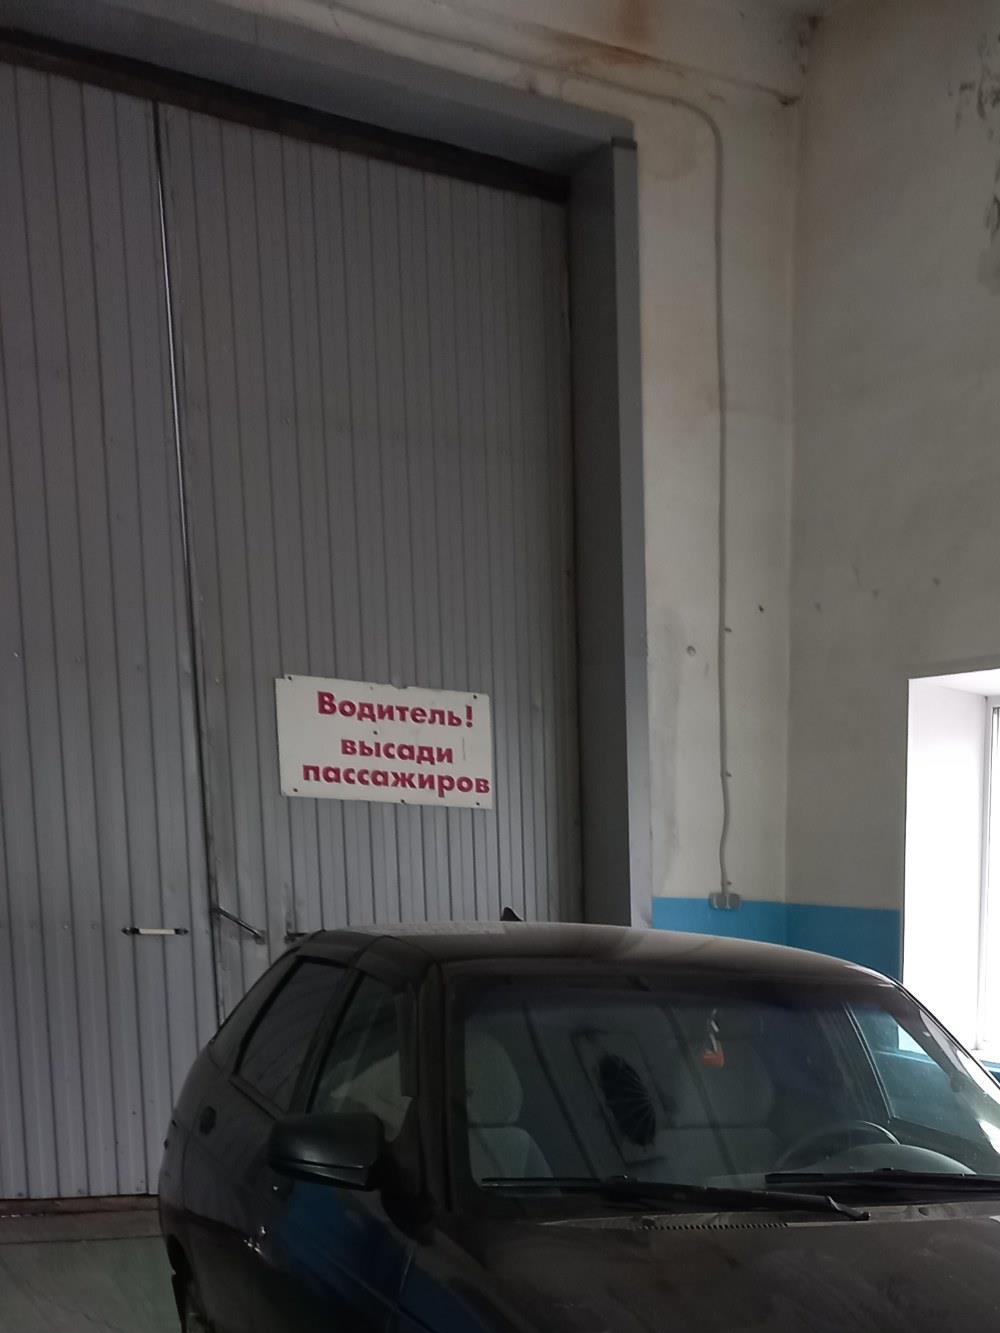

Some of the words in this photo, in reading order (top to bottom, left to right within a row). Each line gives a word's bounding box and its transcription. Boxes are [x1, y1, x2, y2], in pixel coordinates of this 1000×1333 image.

[316, 691, 474, 728] Водитель!
[340, 738, 454, 766] высади
[302, 764, 491, 798] пассажиров
